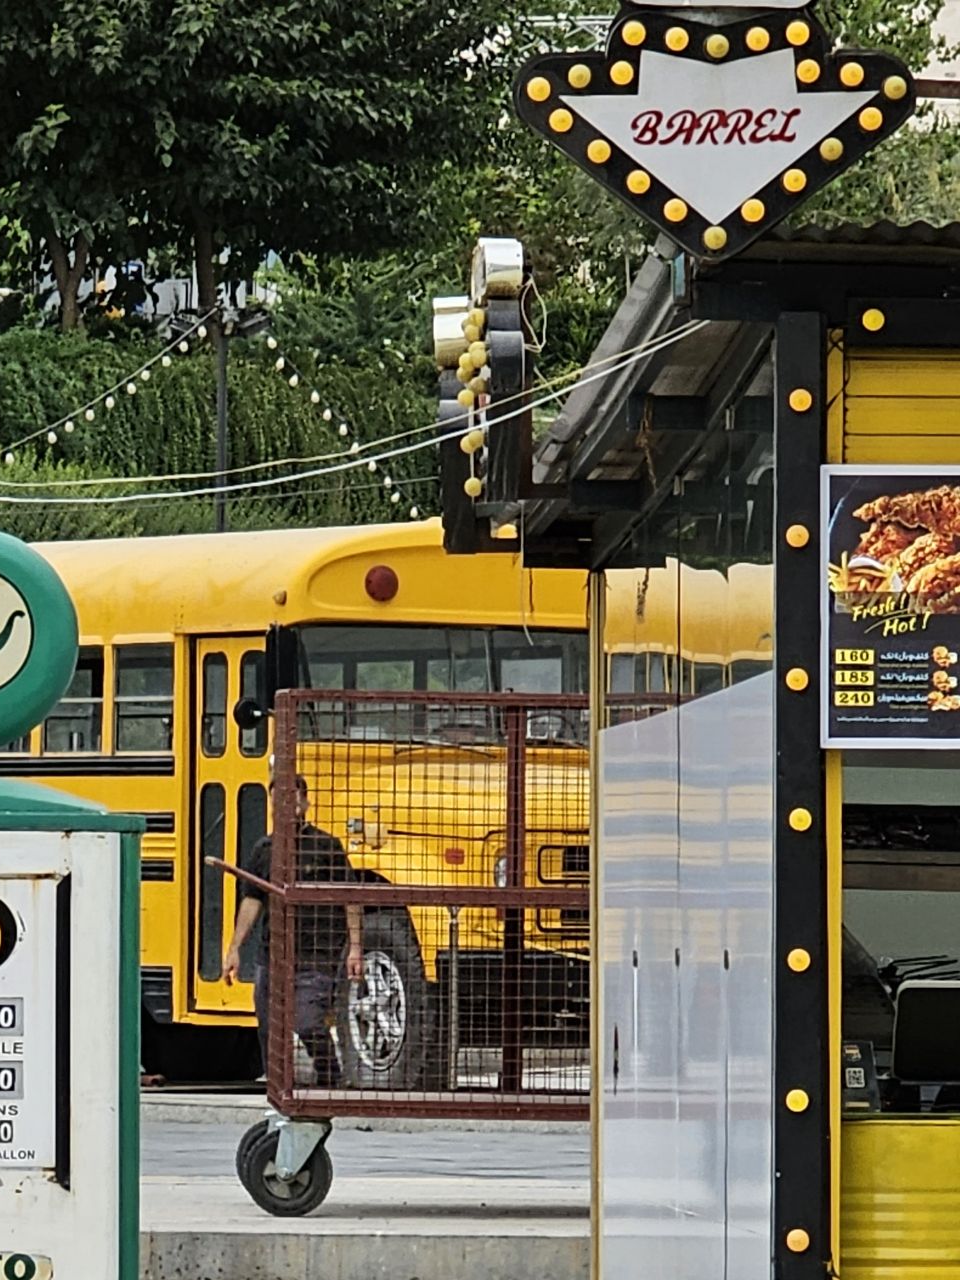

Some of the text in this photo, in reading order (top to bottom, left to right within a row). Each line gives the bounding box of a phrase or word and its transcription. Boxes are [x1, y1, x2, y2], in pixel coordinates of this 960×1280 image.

[630, 108, 801, 145] BARREL
[839, 650, 870, 662] 160
[839, 671, 870, 684] 185
[839, 692, 871, 704] 240
